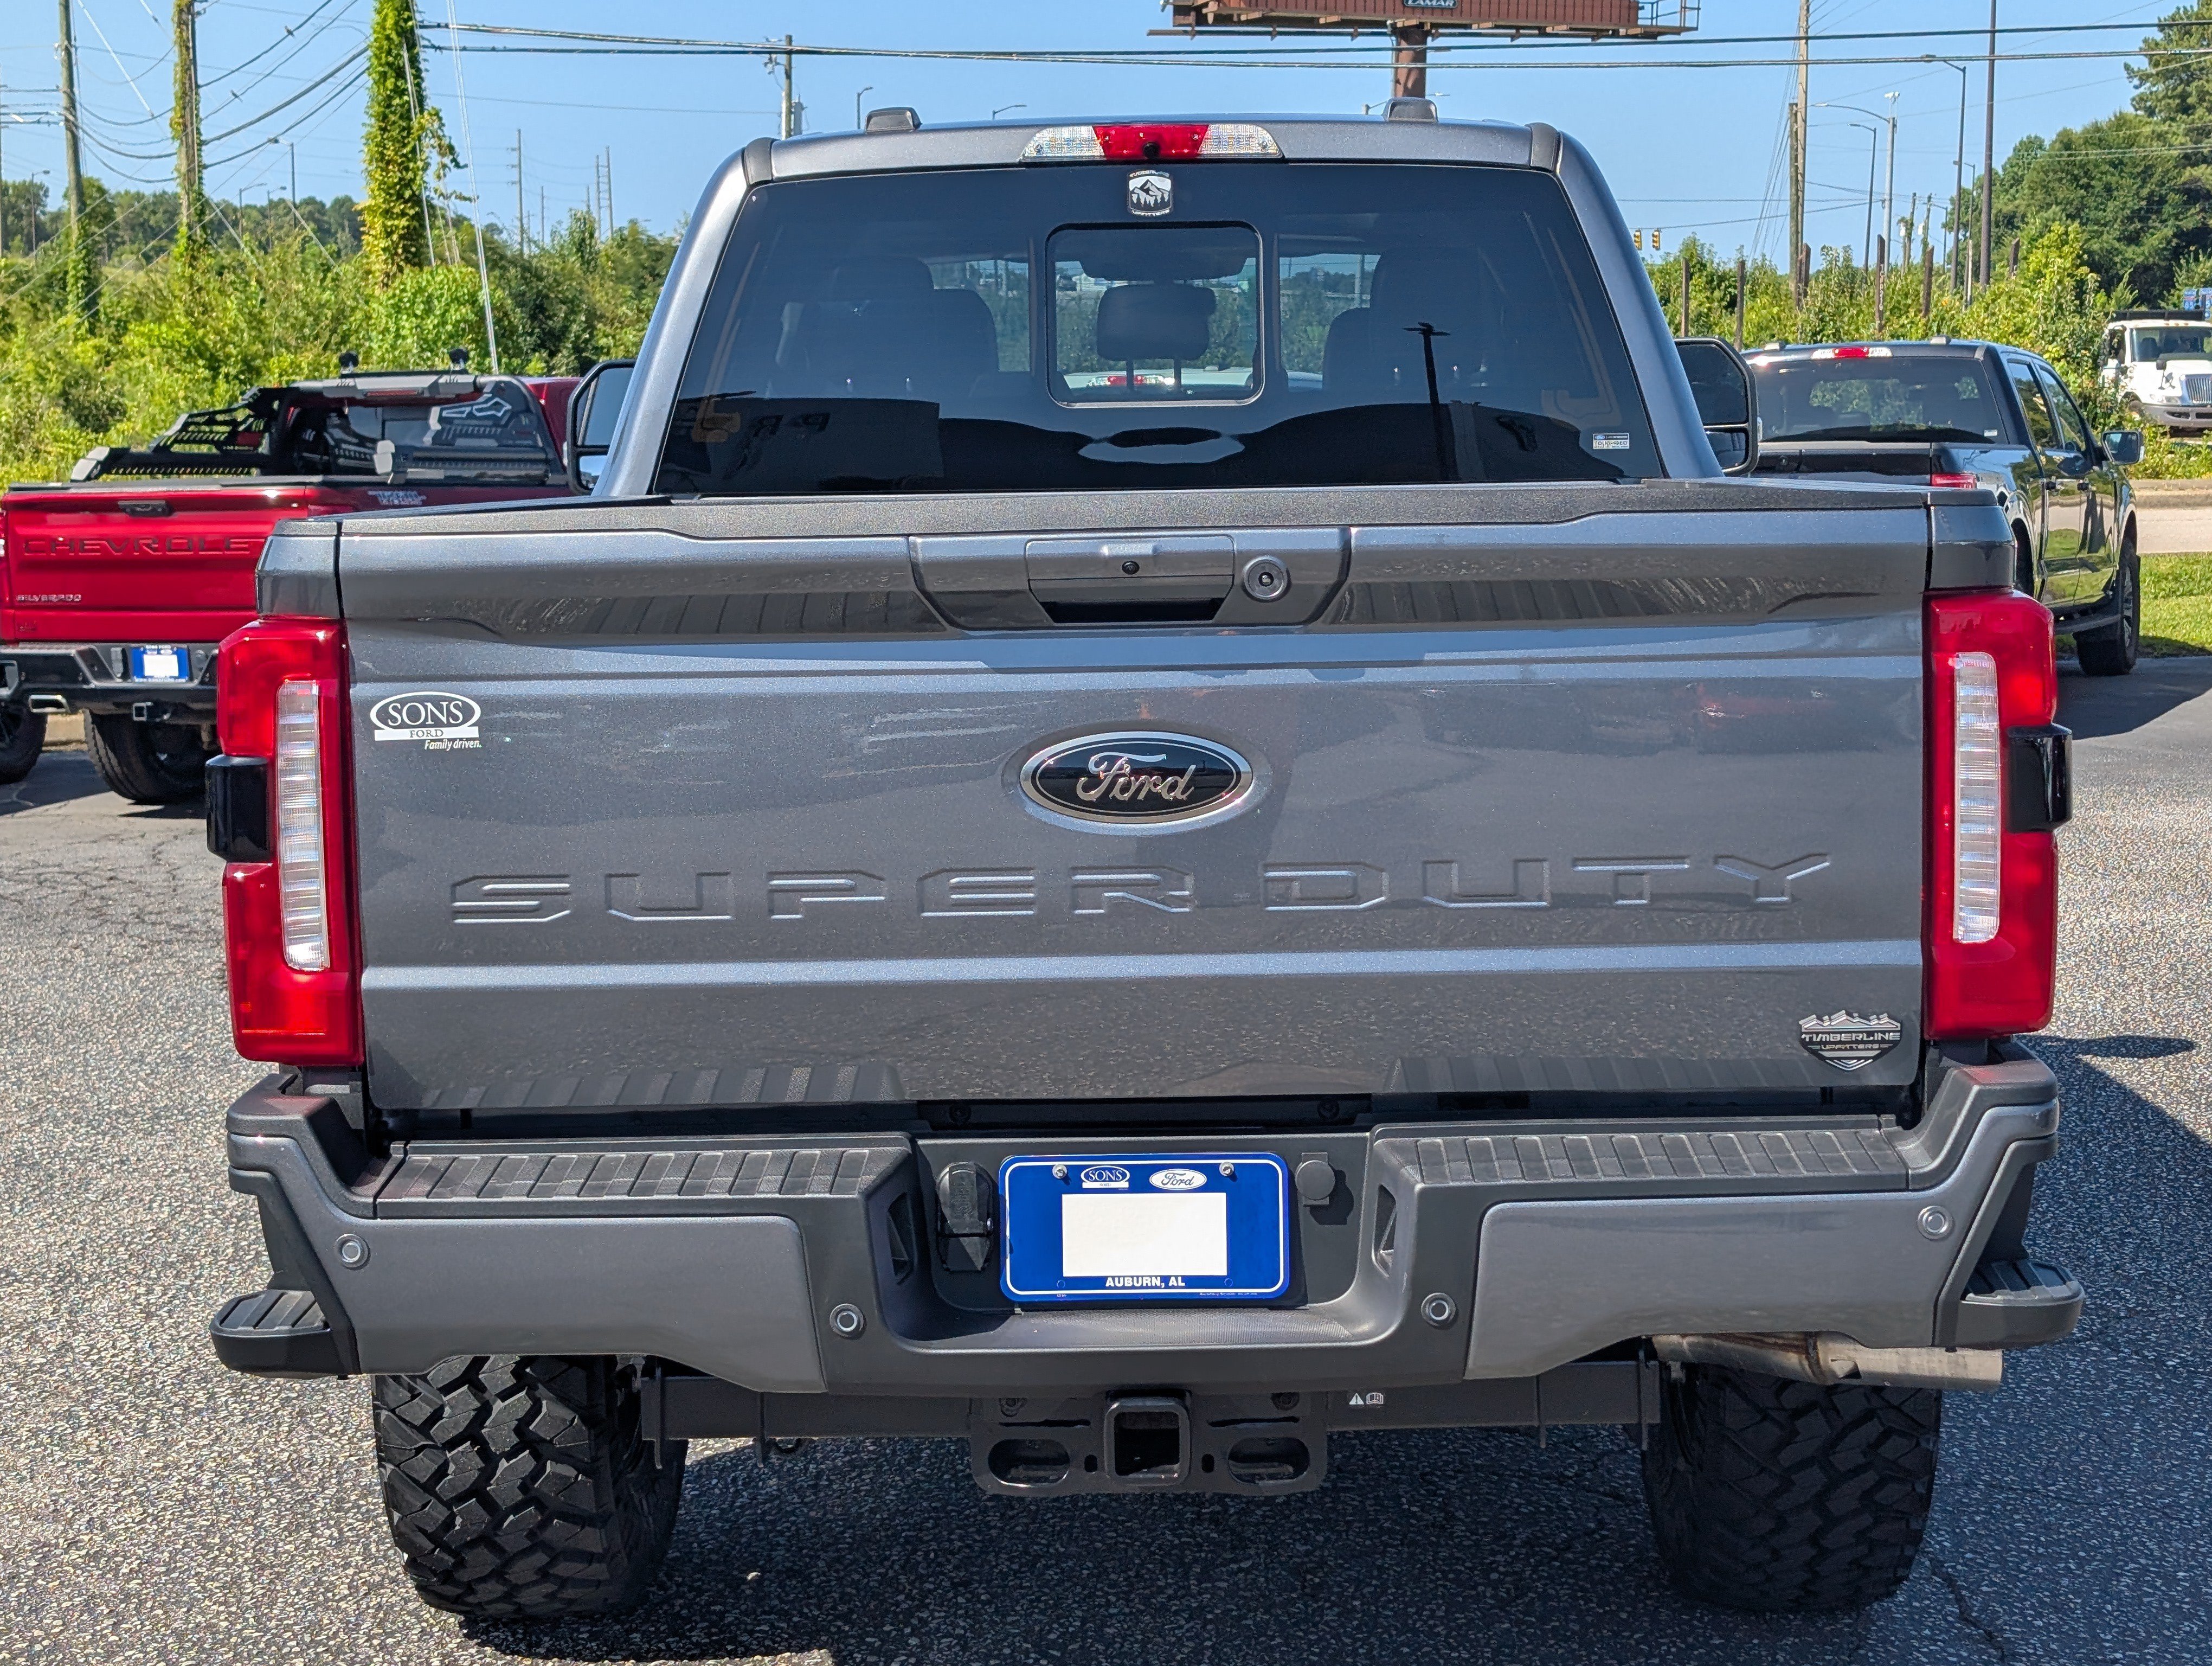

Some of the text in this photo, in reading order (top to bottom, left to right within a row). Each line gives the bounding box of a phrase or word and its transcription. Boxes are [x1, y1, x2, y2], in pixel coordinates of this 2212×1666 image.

[24, 538, 265, 555] CHEVROLE
[388, 701, 464, 726] SONS
[409, 729, 444, 738] FORD
[425, 739, 453, 752] Family
[1076, 752, 1197, 801] Ford
[452, 853, 1831, 924] SUPER DUTY
[1801, 1032, 1901, 1042] TIMBERLINE
[1088, 1170, 1123, 1182] SONS
[1161, 1172, 1195, 1187] Ford
[1105, 1276, 1186, 1289] AUBURN, AL
